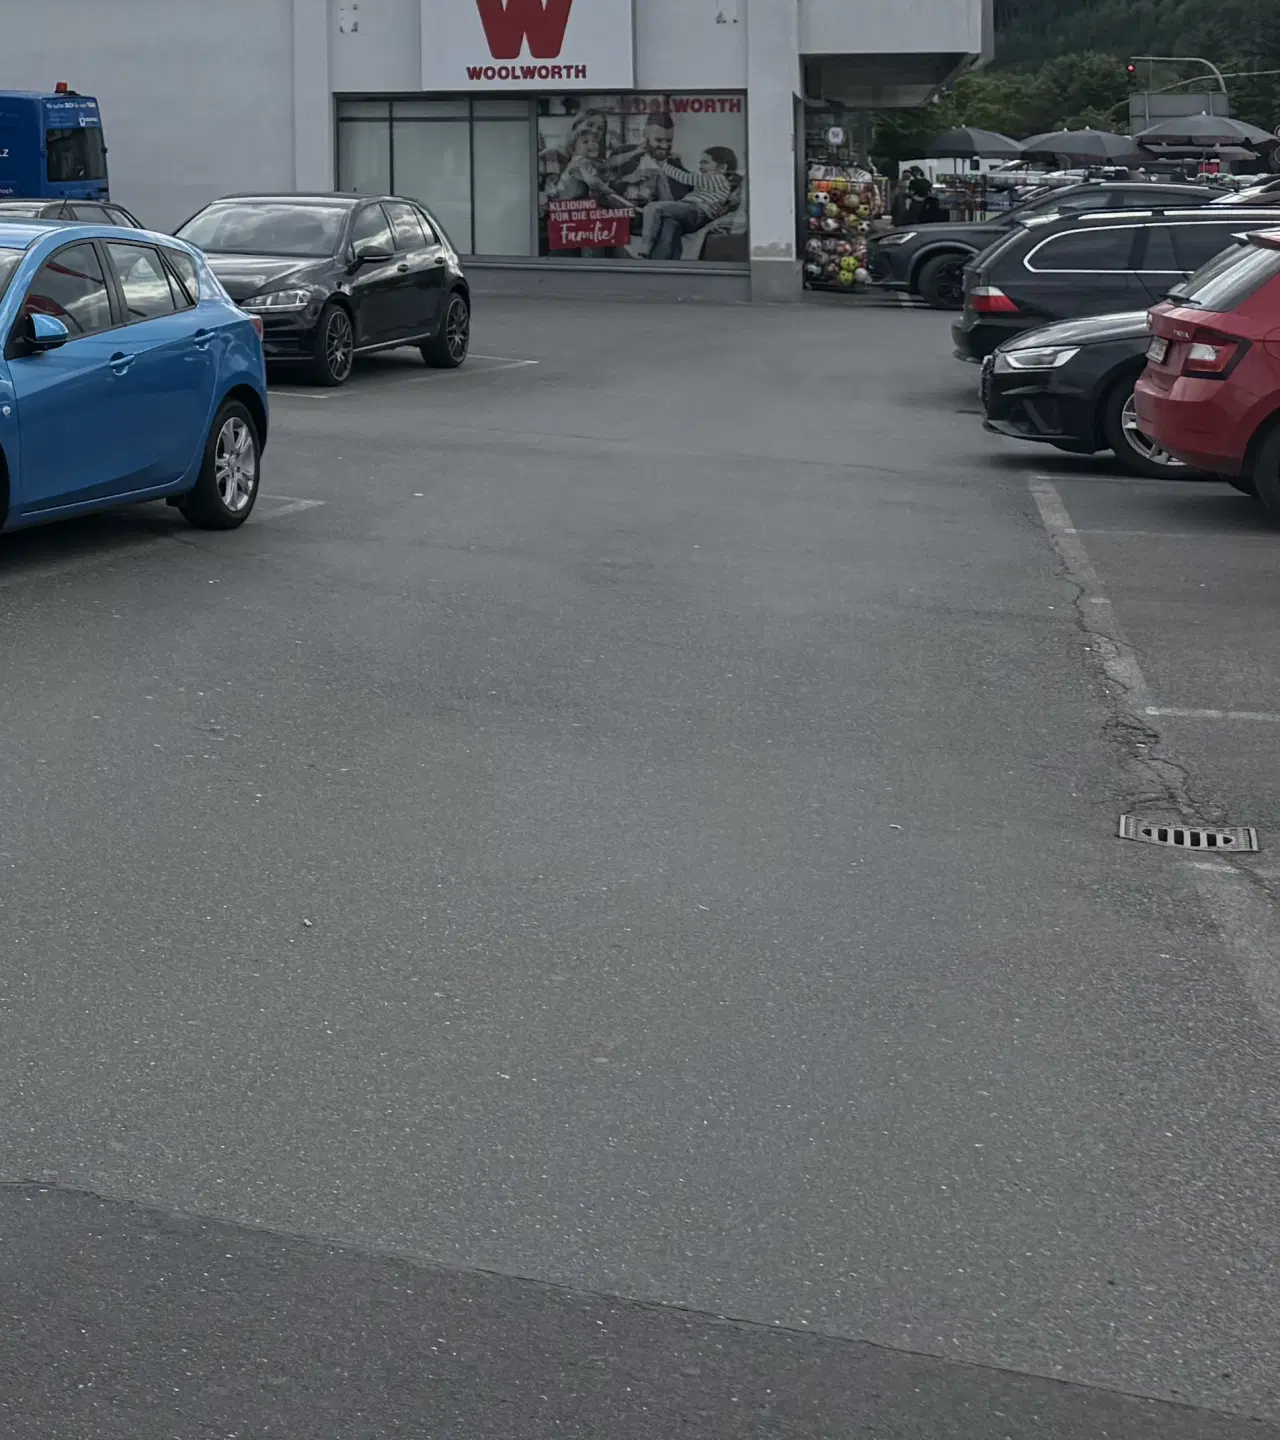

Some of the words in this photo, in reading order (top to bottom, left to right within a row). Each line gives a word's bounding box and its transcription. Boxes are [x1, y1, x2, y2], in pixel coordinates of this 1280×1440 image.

[466, 64, 587, 81] WOOLWORTH
[549, 199, 597, 211] KLEIDUNG
[551, 210, 569, 222] FÜR
[571, 210, 587, 220] DIE
[589, 208, 636, 220] GESAMTE
[559, 220, 617, 245] Familie!
